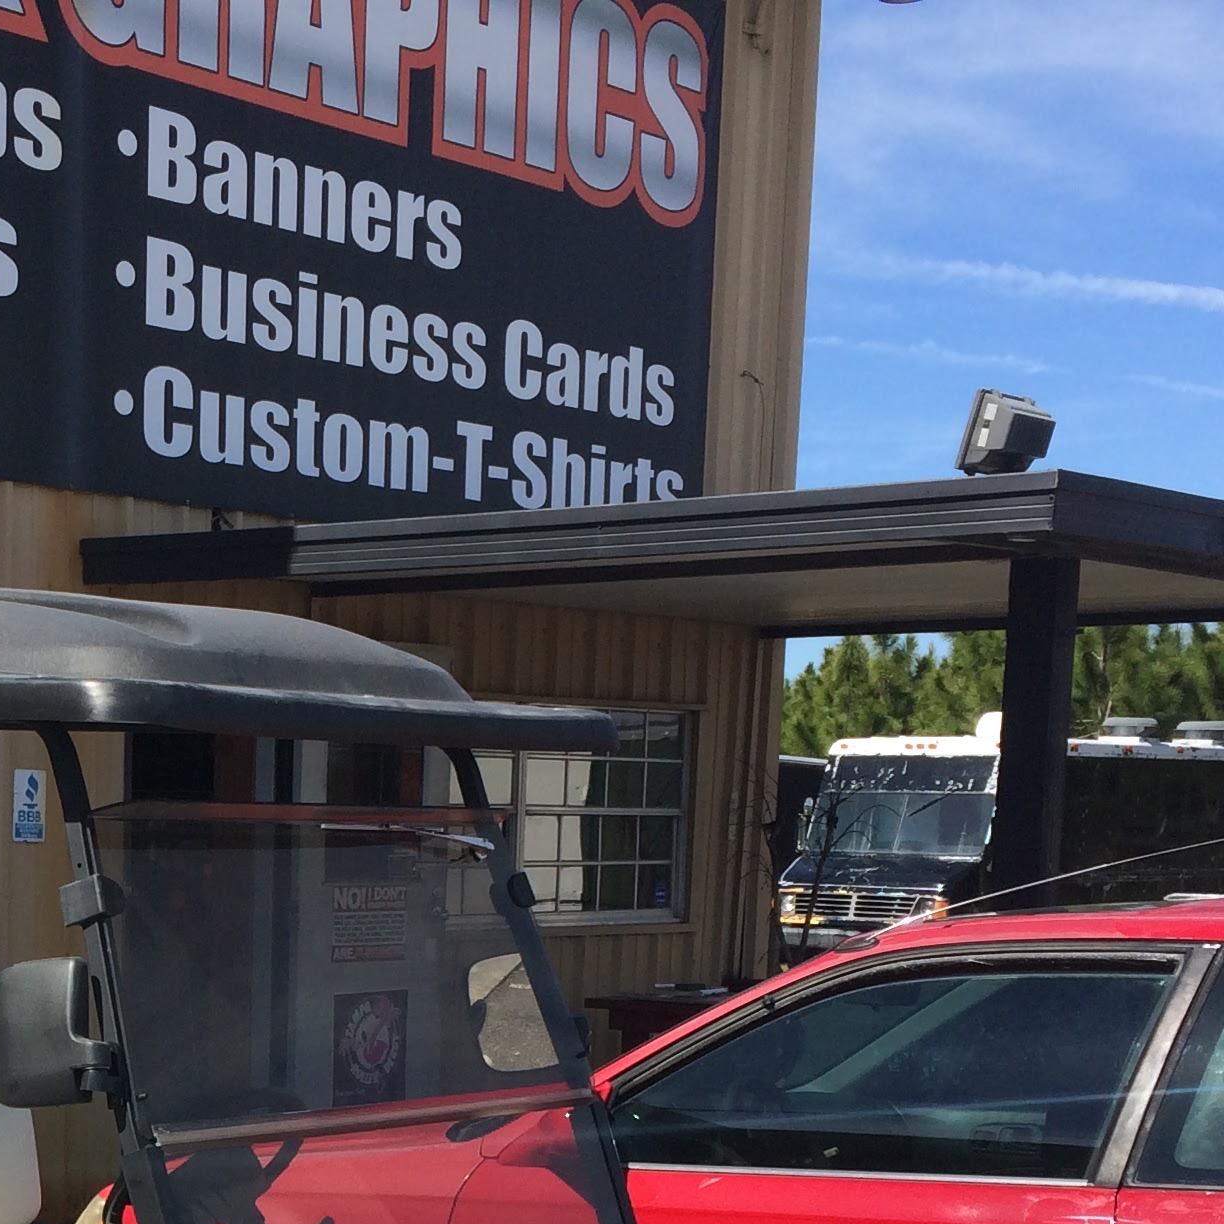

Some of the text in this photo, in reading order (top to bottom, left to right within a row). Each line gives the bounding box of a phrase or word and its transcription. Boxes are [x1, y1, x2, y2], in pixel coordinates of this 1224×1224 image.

[148, 105, 463, 270] Banners
[146, 236, 675, 426] Business Cards
[18, 810, 41, 822] BBB
[334, 887, 366, 910] NO!
